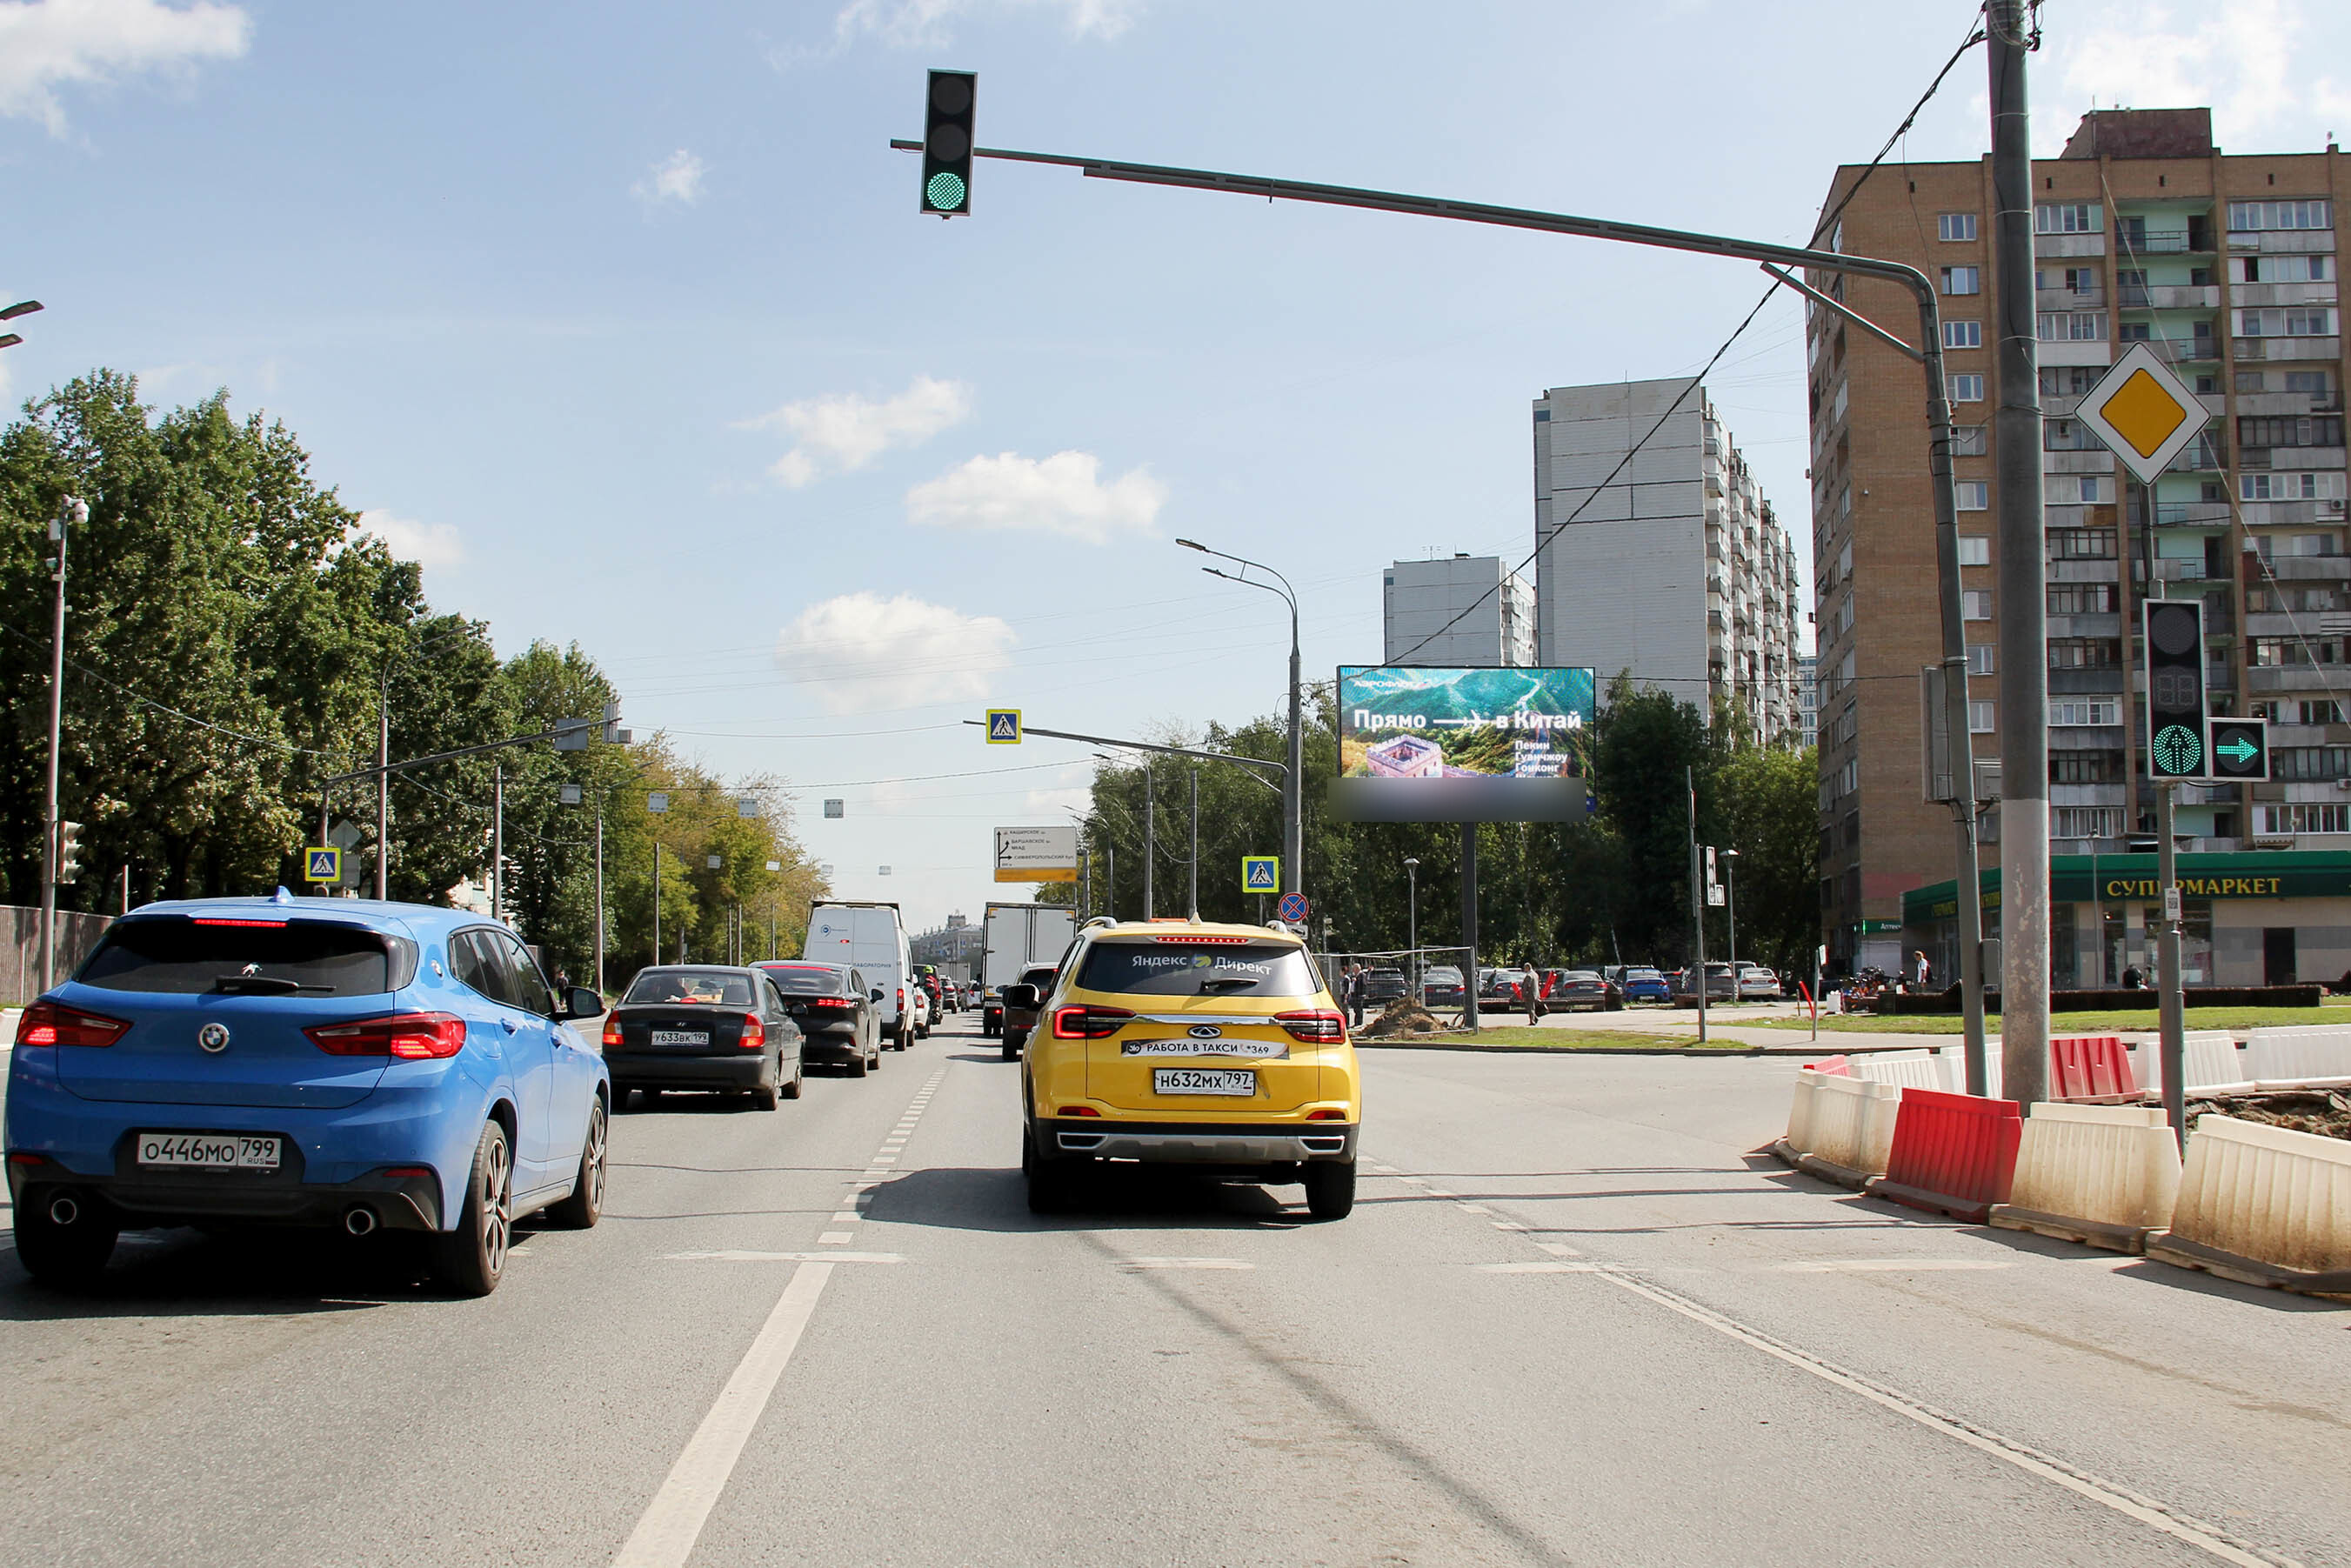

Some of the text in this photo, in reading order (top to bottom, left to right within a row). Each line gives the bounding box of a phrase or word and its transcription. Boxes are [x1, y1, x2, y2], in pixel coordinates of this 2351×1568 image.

[1353, 709, 1581, 732] Прямо в Китай
[1515, 740, 1550, 750] Пекин
[1515, 751, 1568, 764] Гуанчжоу
[1515, 763, 1560, 772] Гонконг
[1132, 955, 1272, 976] Яндекс Директ
[1147, 1043, 1189, 1052] РАБОТА
[1192, 1043, 1199, 1052] В
[1202, 1043, 1238, 1052] ТАКСИ
